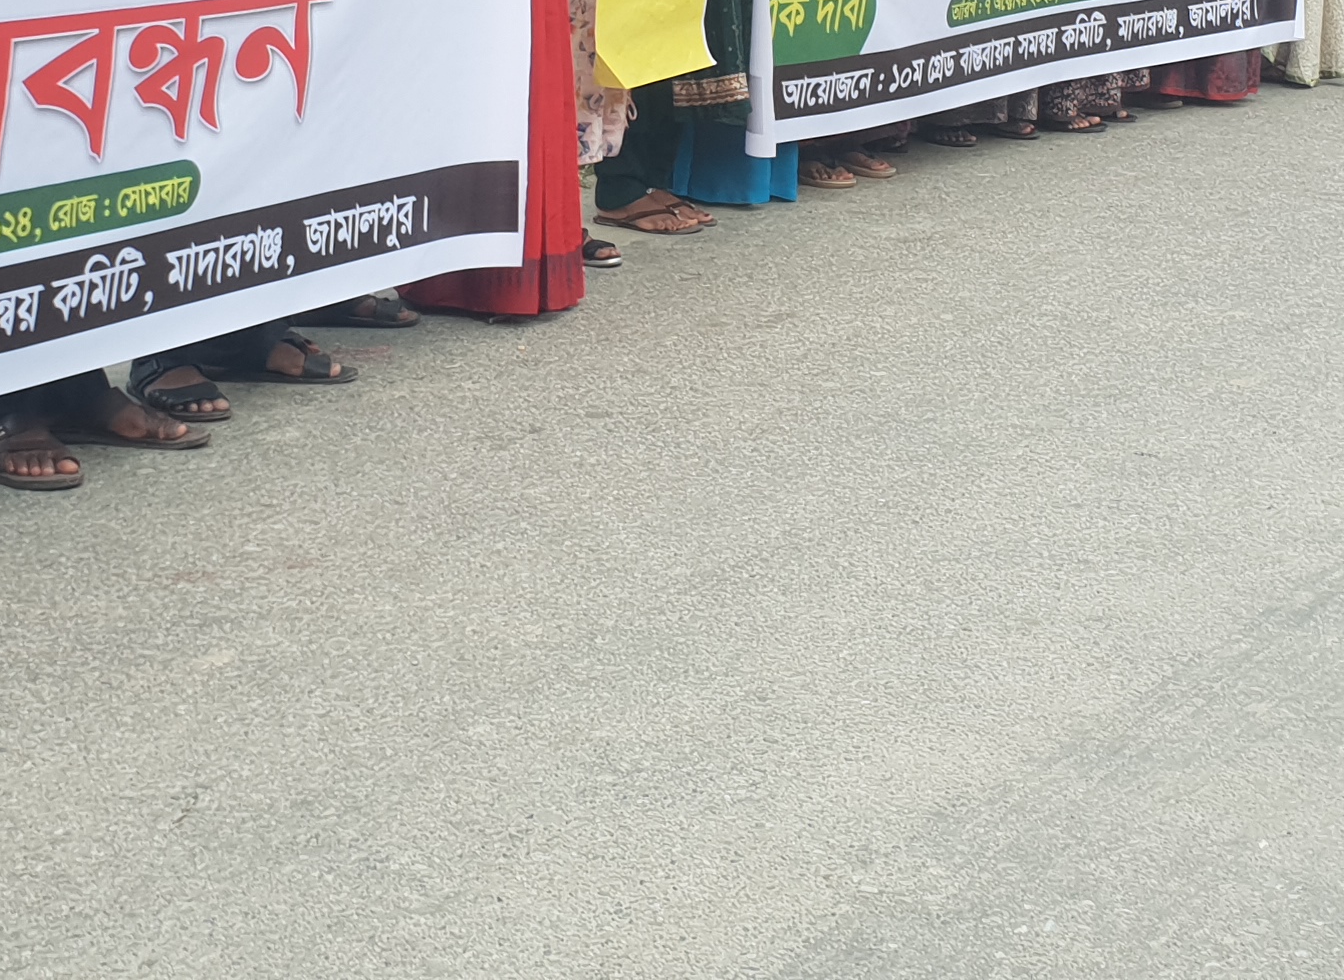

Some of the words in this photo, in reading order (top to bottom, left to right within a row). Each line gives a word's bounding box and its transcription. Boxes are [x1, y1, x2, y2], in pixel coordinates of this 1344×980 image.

[782, 68, 875, 110] আয়োজনে
[889, 59, 924, 92] ১০ম
[927, 50, 956, 83] গ্রেড
[959, 36, 1015, 76] বাস্তবায়ন
[1017, 27, 1058, 61] সমন্বয়
[49, 193, 97, 232] রোজ
[116, 175, 193, 217] সোমবার
[52, 247, 154, 321] কমিটি,
[166, 225, 295, 293] মাদারগঞ্জ,
[304, 194, 431, 256] জামালপুর।
